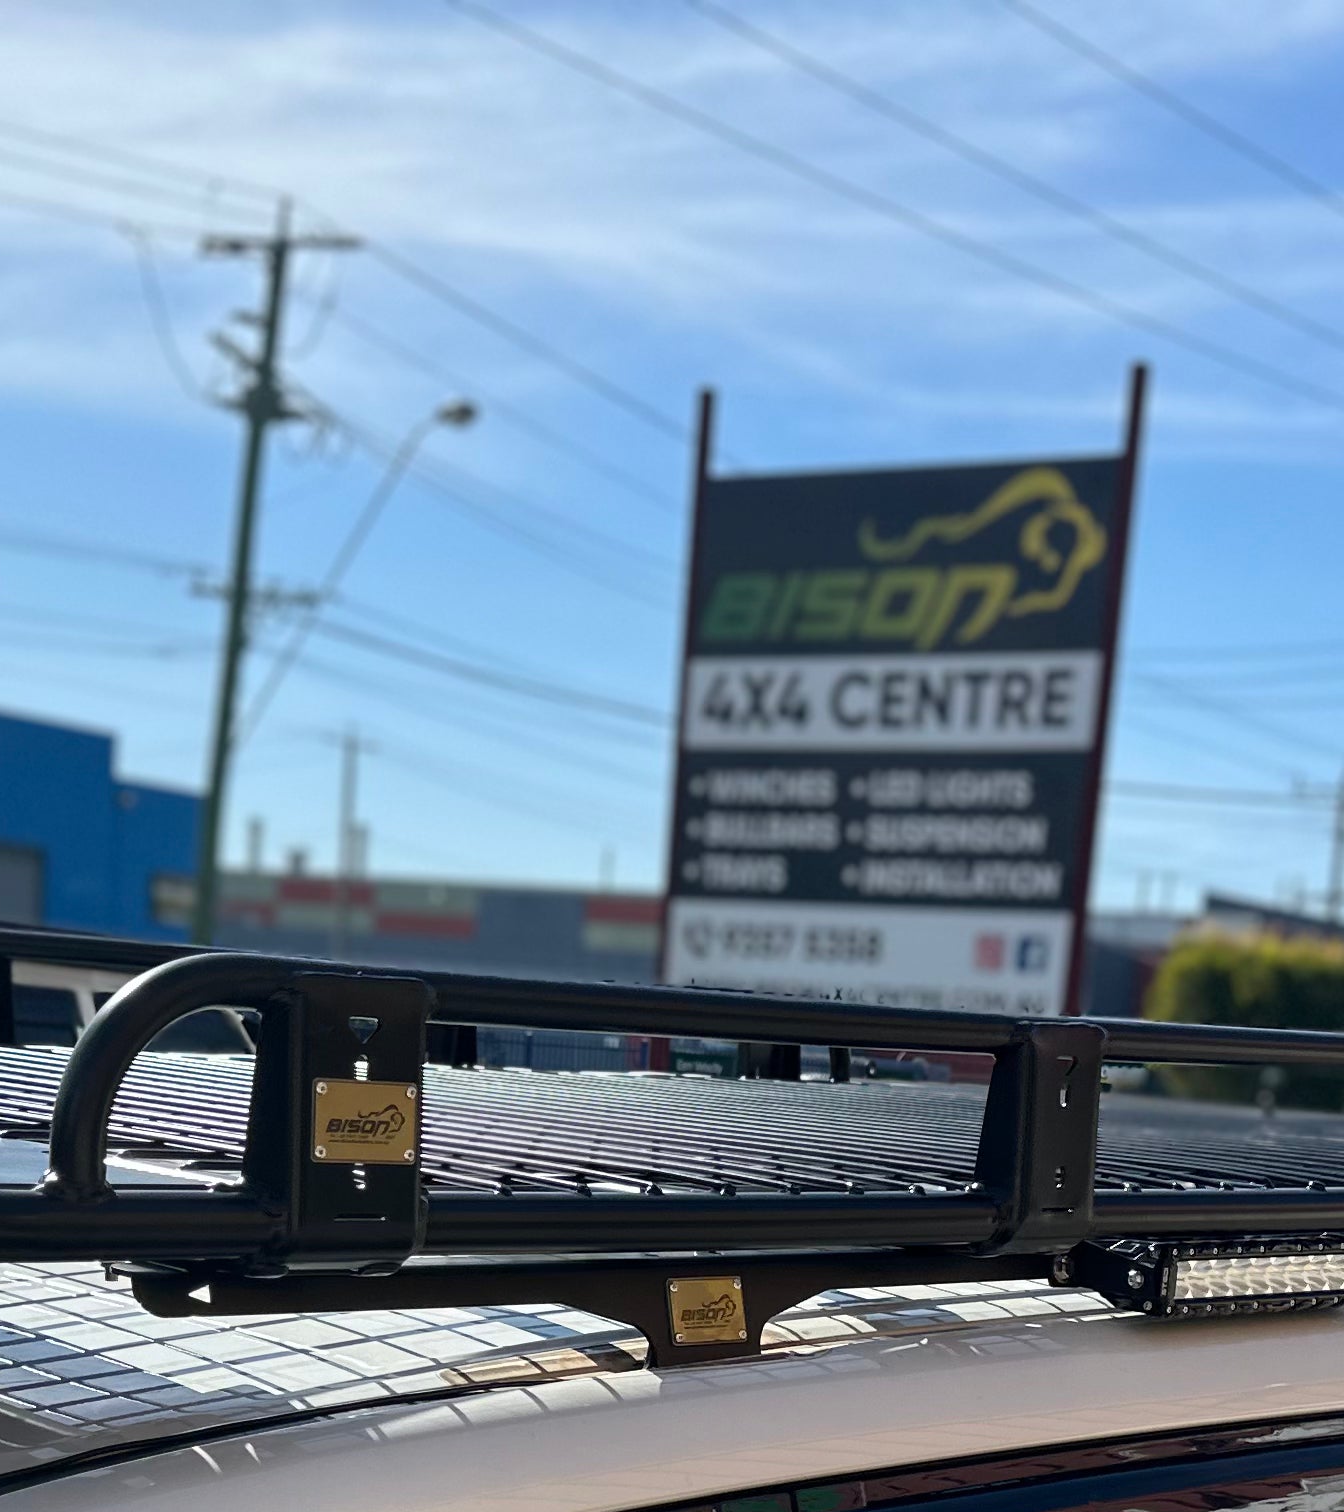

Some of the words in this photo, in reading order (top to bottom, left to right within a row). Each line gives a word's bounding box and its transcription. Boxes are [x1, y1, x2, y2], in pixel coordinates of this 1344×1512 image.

[701, 668, 810, 732] 4X4
[829, 666, 1075, 733] CENTRE
[708, 770, 837, 807] WINCHES
[926, 770, 1033, 809] LIGHTS
[704, 811, 839, 849] BULLBARS
[864, 815, 1047, 853] SUSPENSION
[859, 858, 1061, 898] INSTALLATION
